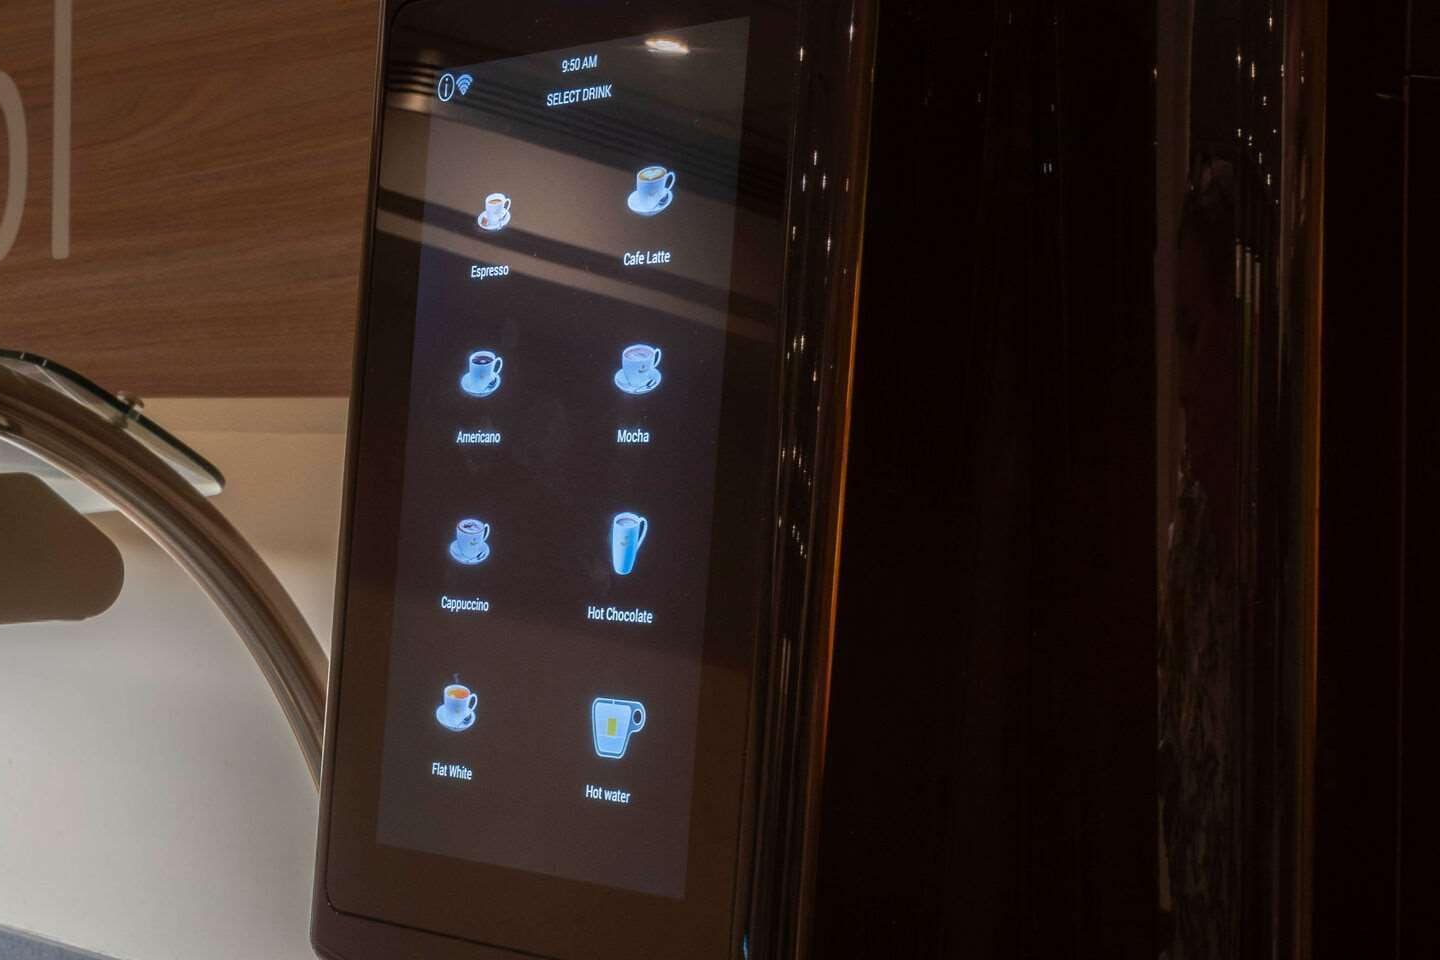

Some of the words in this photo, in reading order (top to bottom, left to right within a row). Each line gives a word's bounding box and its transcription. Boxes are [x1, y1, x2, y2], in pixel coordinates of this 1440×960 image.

[562, 58, 581, 72] 9:50
[582, 55, 597, 69] AM
[547, 88, 582, 106] SELECT
[583, 84, 612, 101] DRINK
[624, 251, 644, 266] Cafe
[646, 250, 671, 265] Latte
[471, 264, 509, 280] Espresso
[456, 430, 501, 444] Americano
[617, 429, 650, 443] Mocha
[441, 596, 489, 612] Cappuccino
[587, 605, 604, 621] Hot
[606, 606, 653, 623] Chocolate
[432, 762, 448, 777] Flat
[449, 765, 472, 780] White
[585, 783, 603, 800] Hot
[604, 788, 631, 803] water
